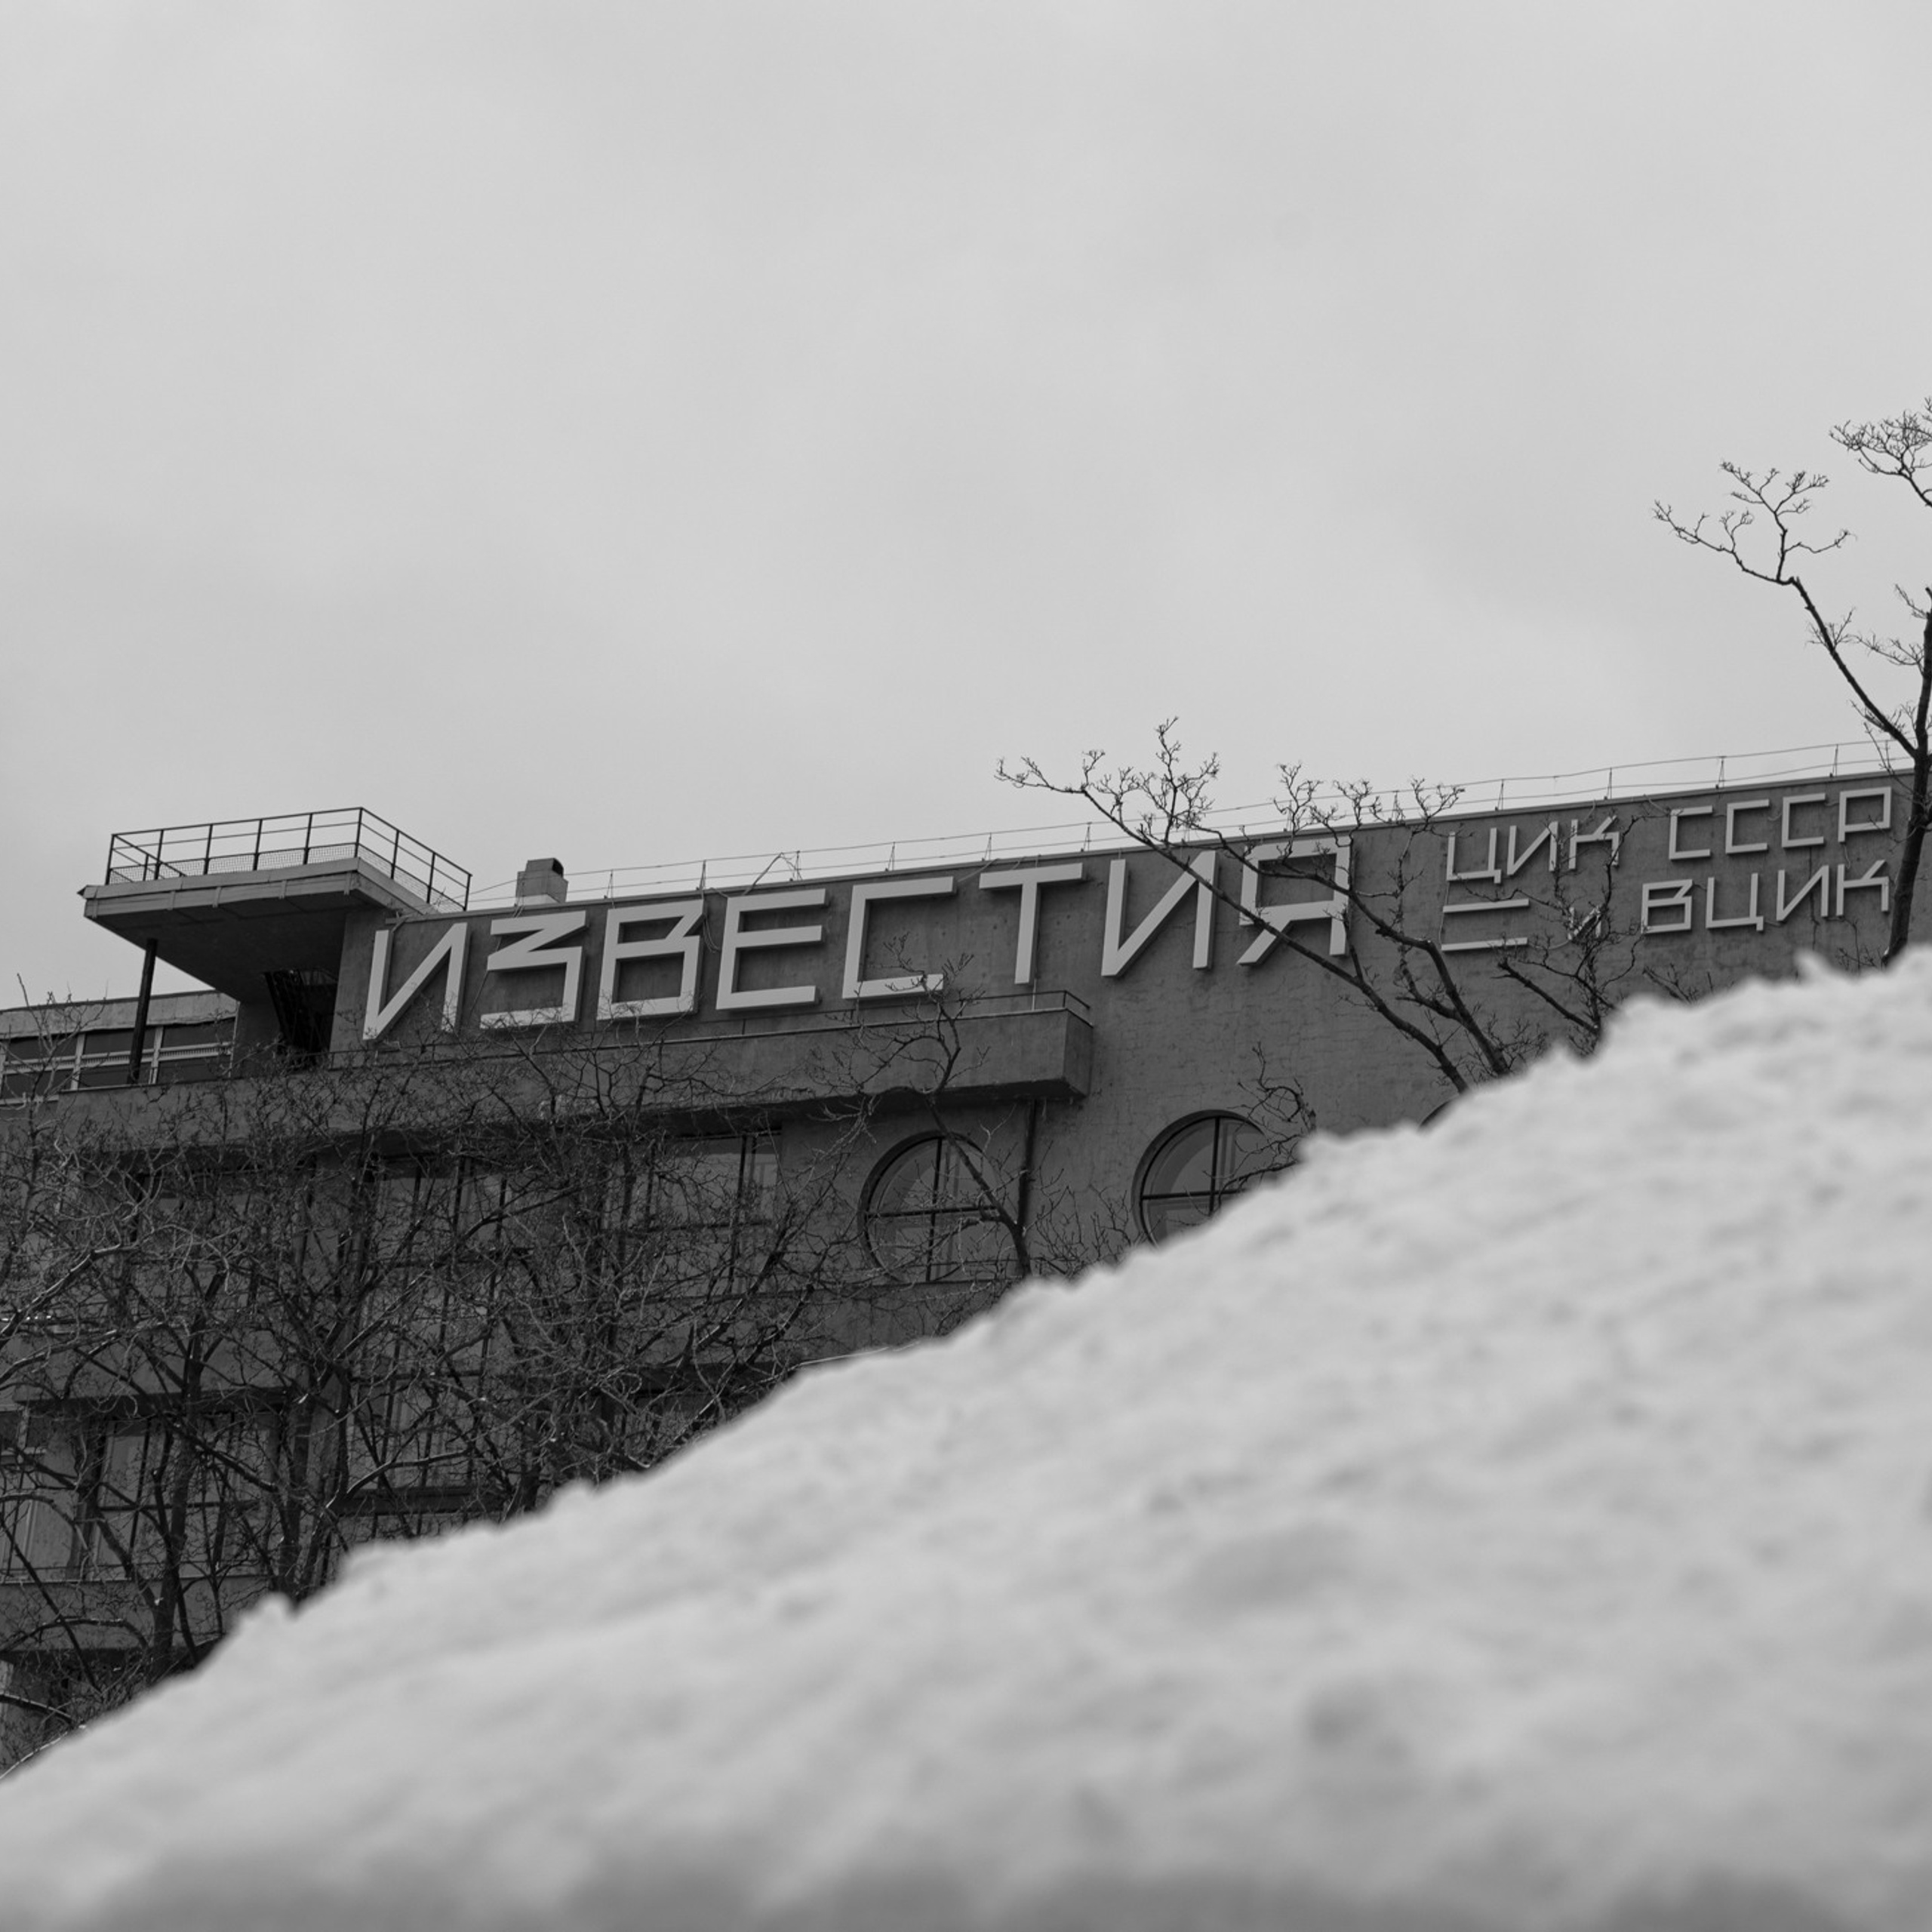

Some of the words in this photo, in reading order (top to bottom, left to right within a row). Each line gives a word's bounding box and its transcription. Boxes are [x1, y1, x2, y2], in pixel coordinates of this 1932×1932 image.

[1446, 815, 1620, 884] ЦИК
[1669, 786, 1891, 860] СССР
[363, 838, 1352, 1041] ИЗВЕСТИЯ
[1641, 860, 1889, 934] ВЦИК
